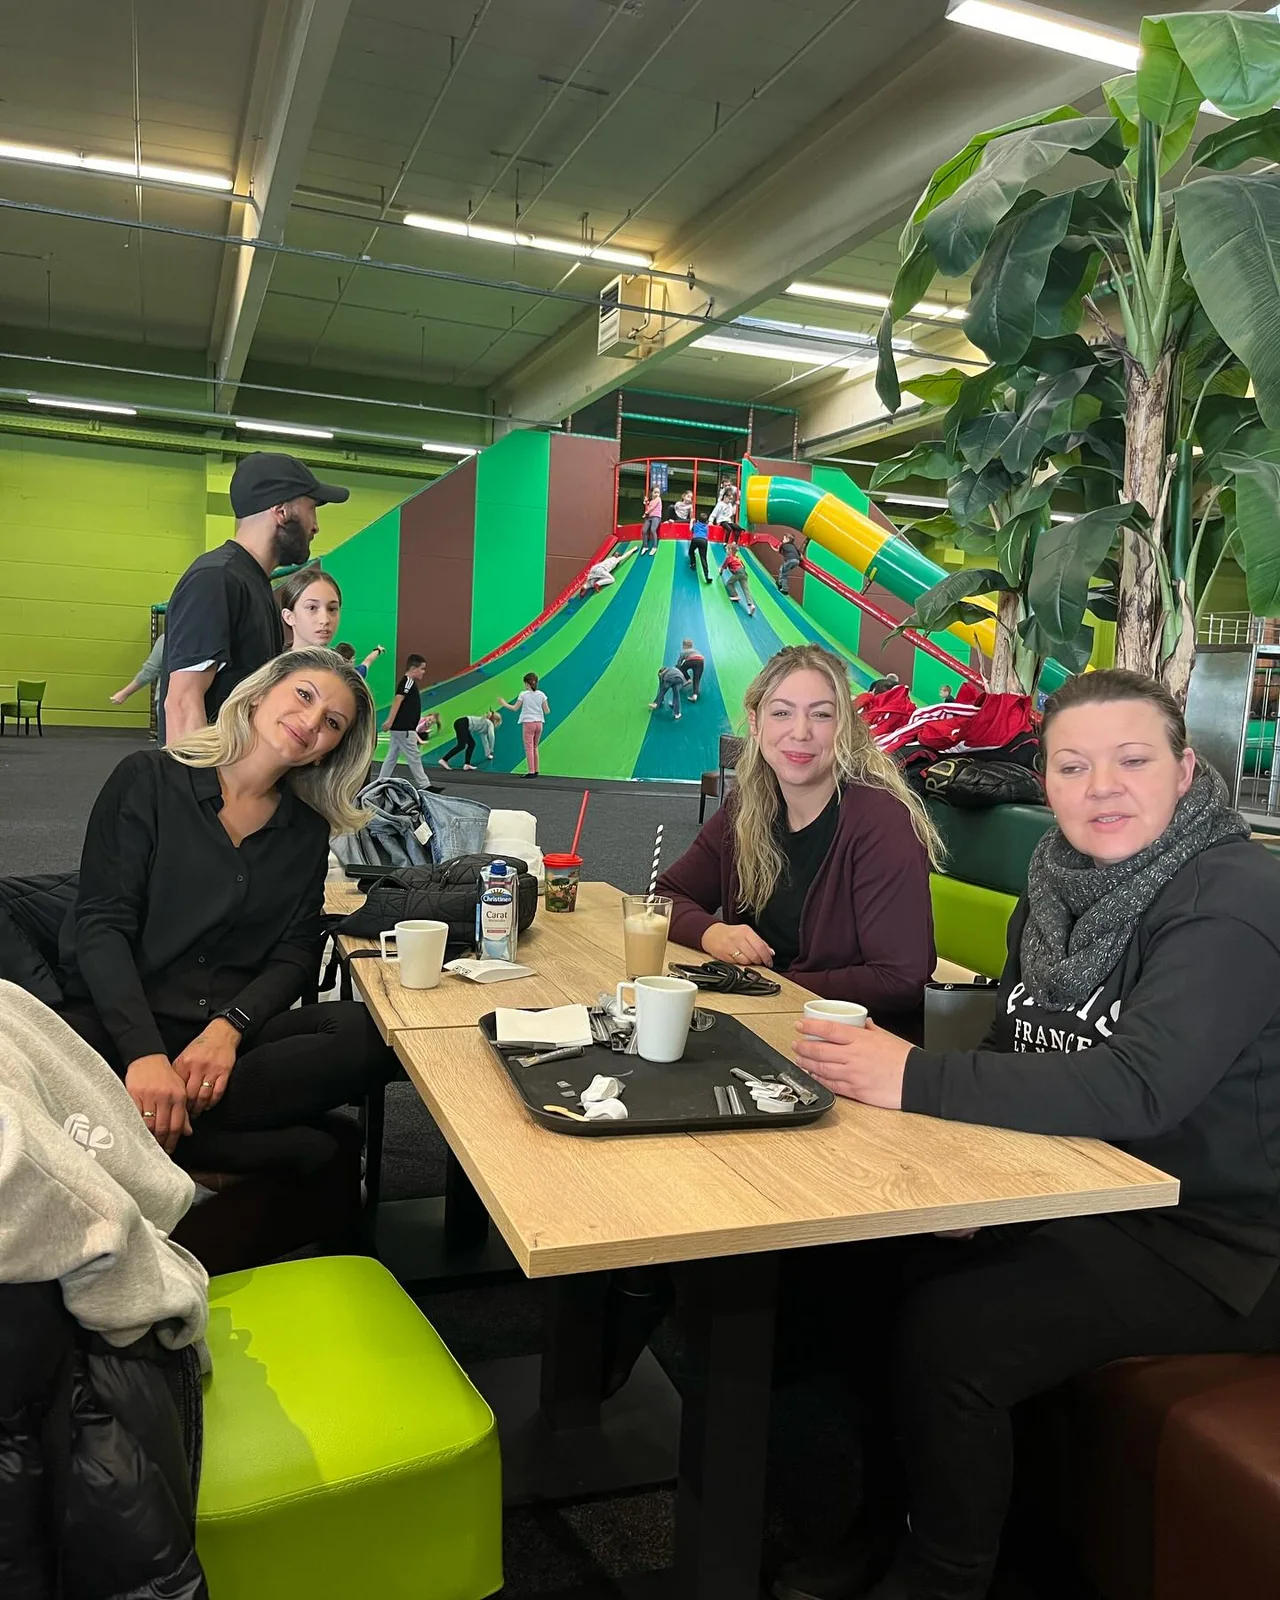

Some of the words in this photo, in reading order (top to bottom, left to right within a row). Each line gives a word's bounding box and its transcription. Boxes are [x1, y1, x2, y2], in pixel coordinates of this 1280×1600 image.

[482, 895, 512, 903] Christinen
[486, 910, 508, 919] Carat
[1014, 1018, 1093, 1054] FRANCE
